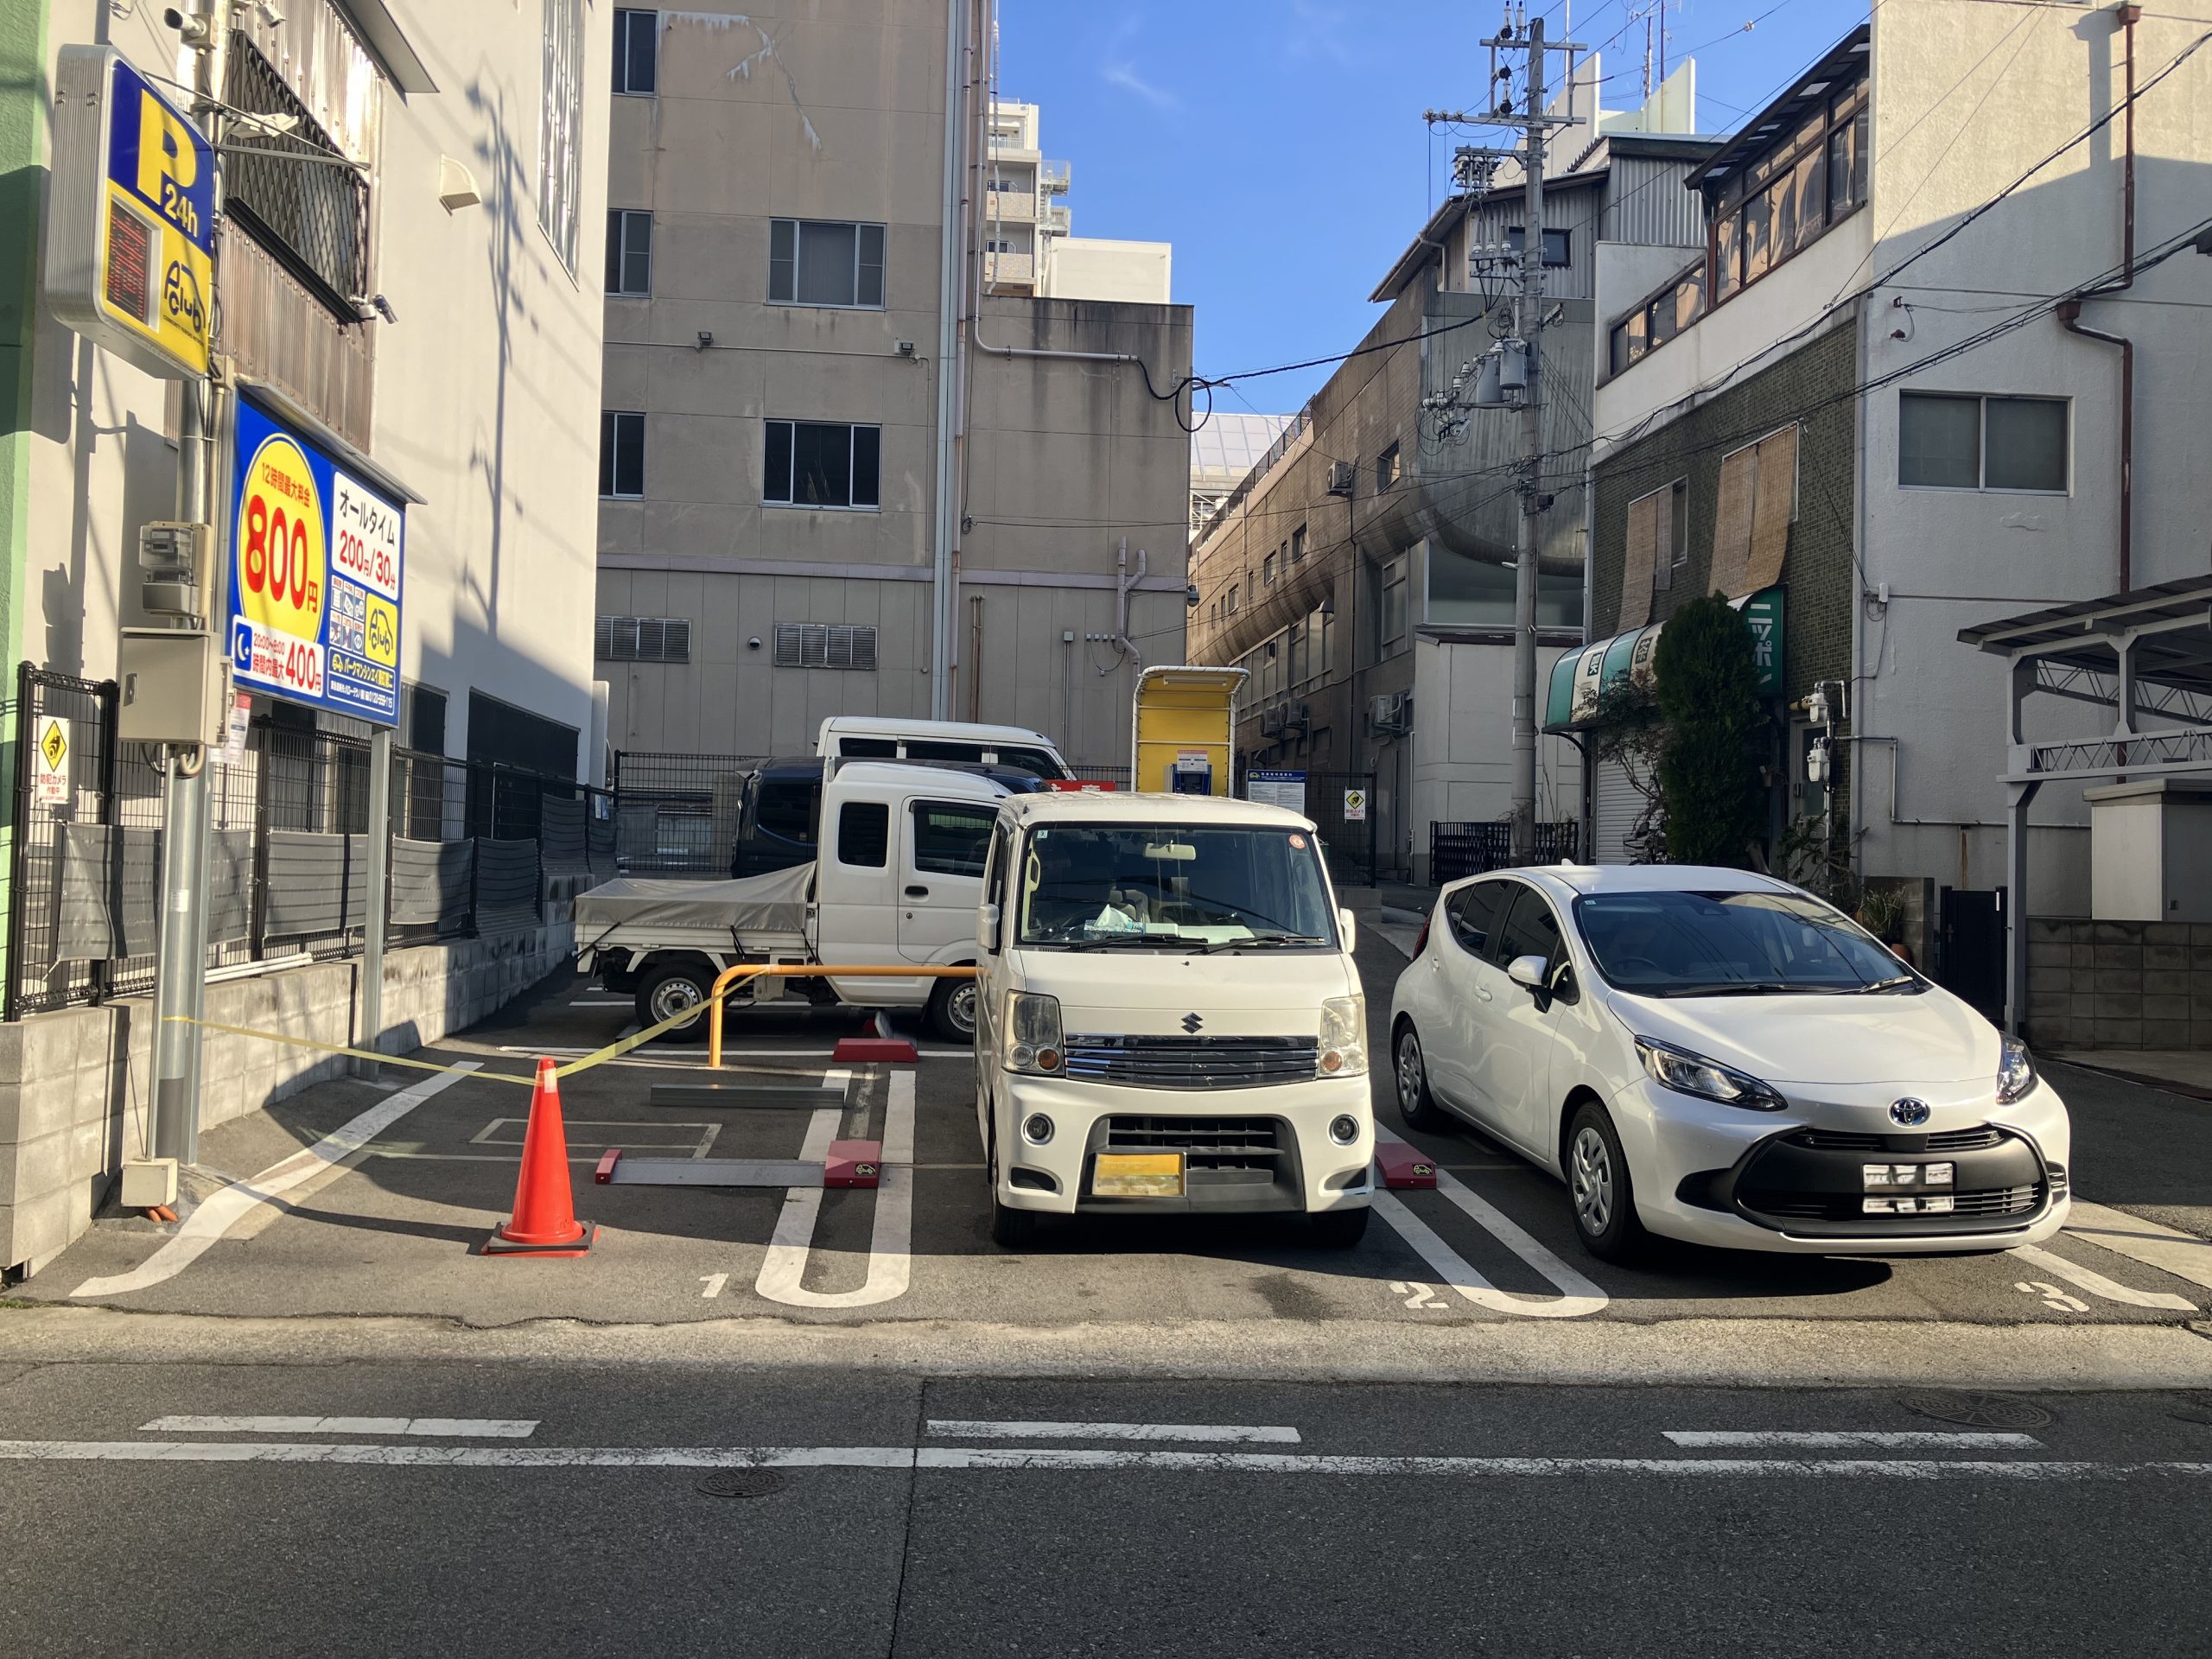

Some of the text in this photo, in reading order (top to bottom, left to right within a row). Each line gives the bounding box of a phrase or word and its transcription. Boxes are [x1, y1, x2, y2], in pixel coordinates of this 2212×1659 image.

[137, 88, 196, 206] P
[164, 183, 198, 238] 24h
[262, 462, 310, 508] 12時間最大料金
[340, 489, 395, 546] オールタイム
[245, 494, 318, 613] 800円
[340, 530, 396, 590] 200円/30分
[252, 653, 284, 680] 時間内最大
[285, 641, 321, 691] 400円
[40, 773, 67, 785] 防犯カメラ
[698, 1273, 729, 1299] 1
[1389, 1281, 1450, 1309] 2
[2014, 1281, 2090, 1312] 3
